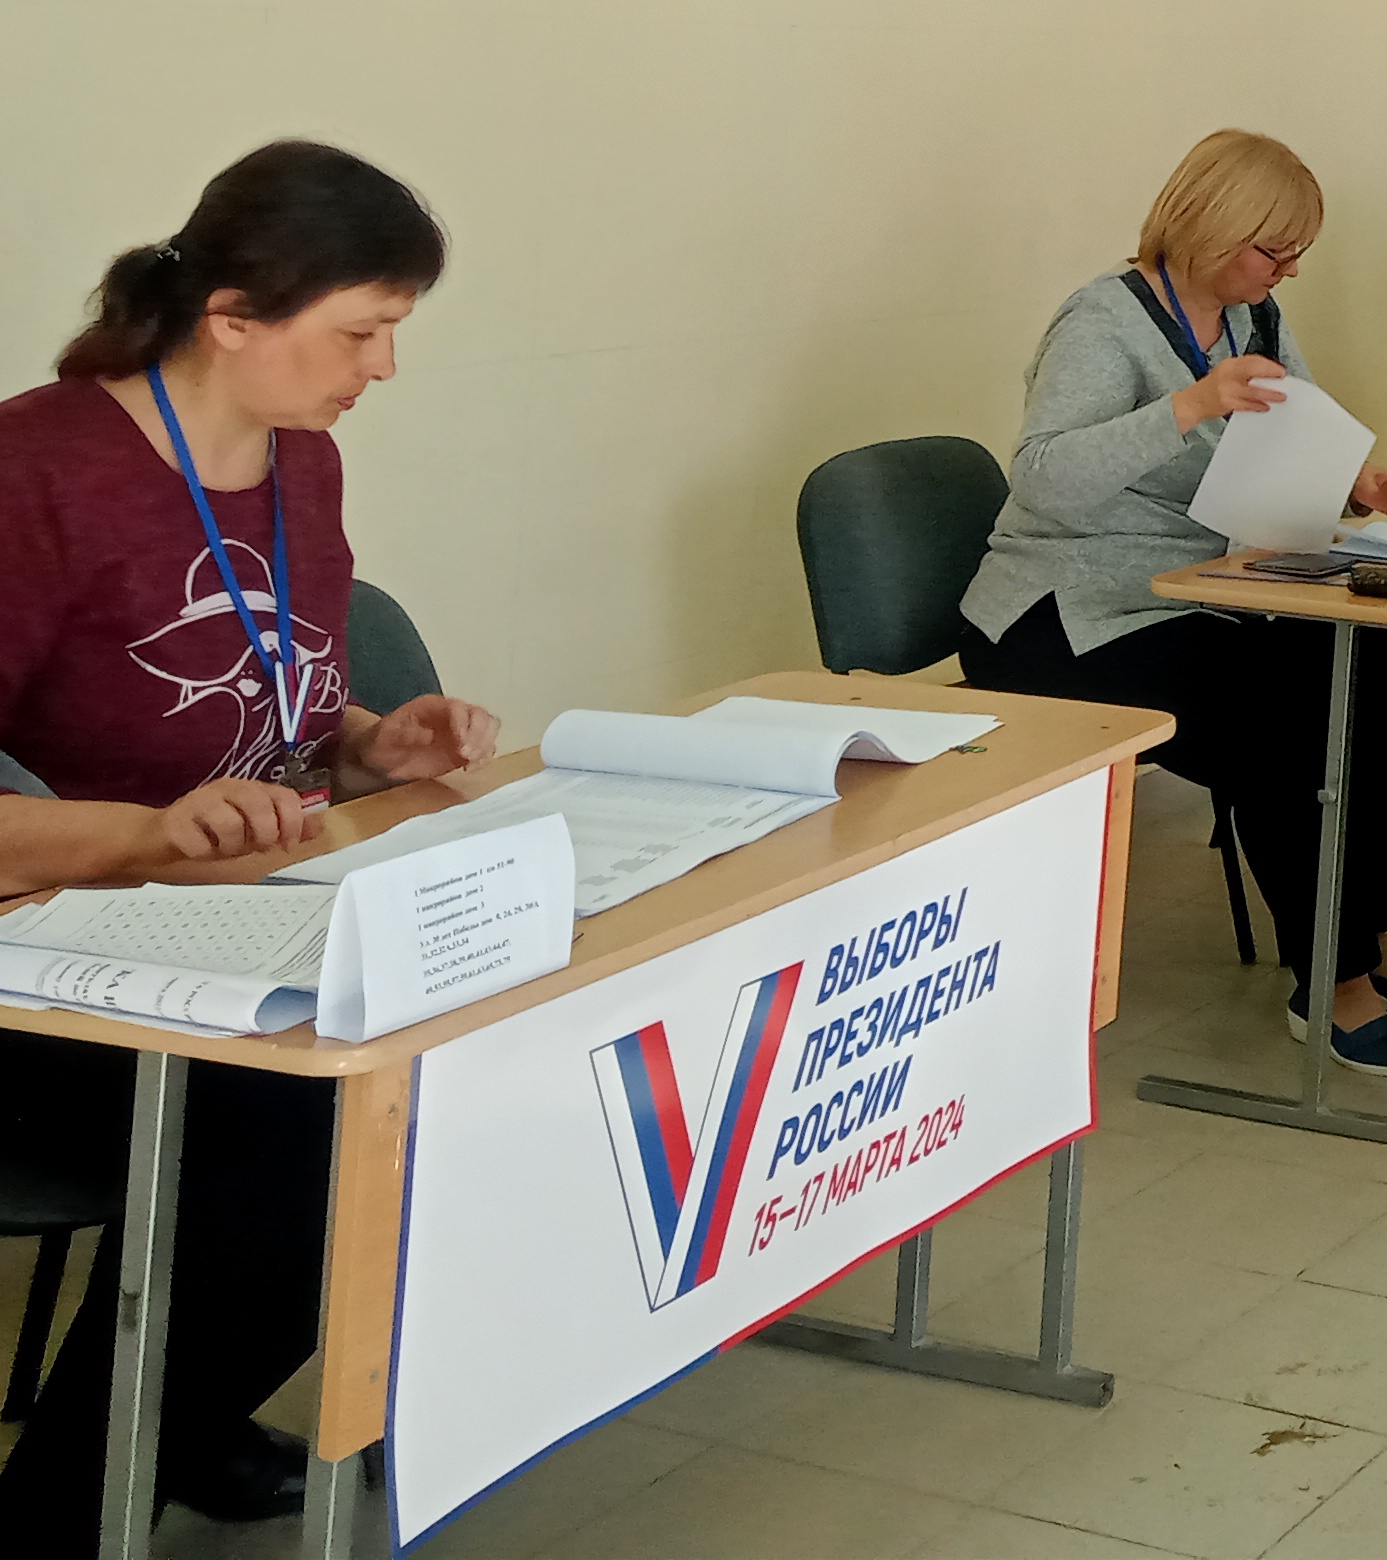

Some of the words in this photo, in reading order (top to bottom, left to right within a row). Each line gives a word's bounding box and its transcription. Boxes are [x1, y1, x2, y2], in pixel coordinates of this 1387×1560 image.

[815, 886, 968, 1006] ВЫБОРЫ
[792, 940, 1001, 1093] ПРЕЗИДЕНТА
[766, 1054, 914, 1181] РОССИИ
[821, 1125, 908, 1215] МАРТА
[906, 1094, 965, 1167] 2024
